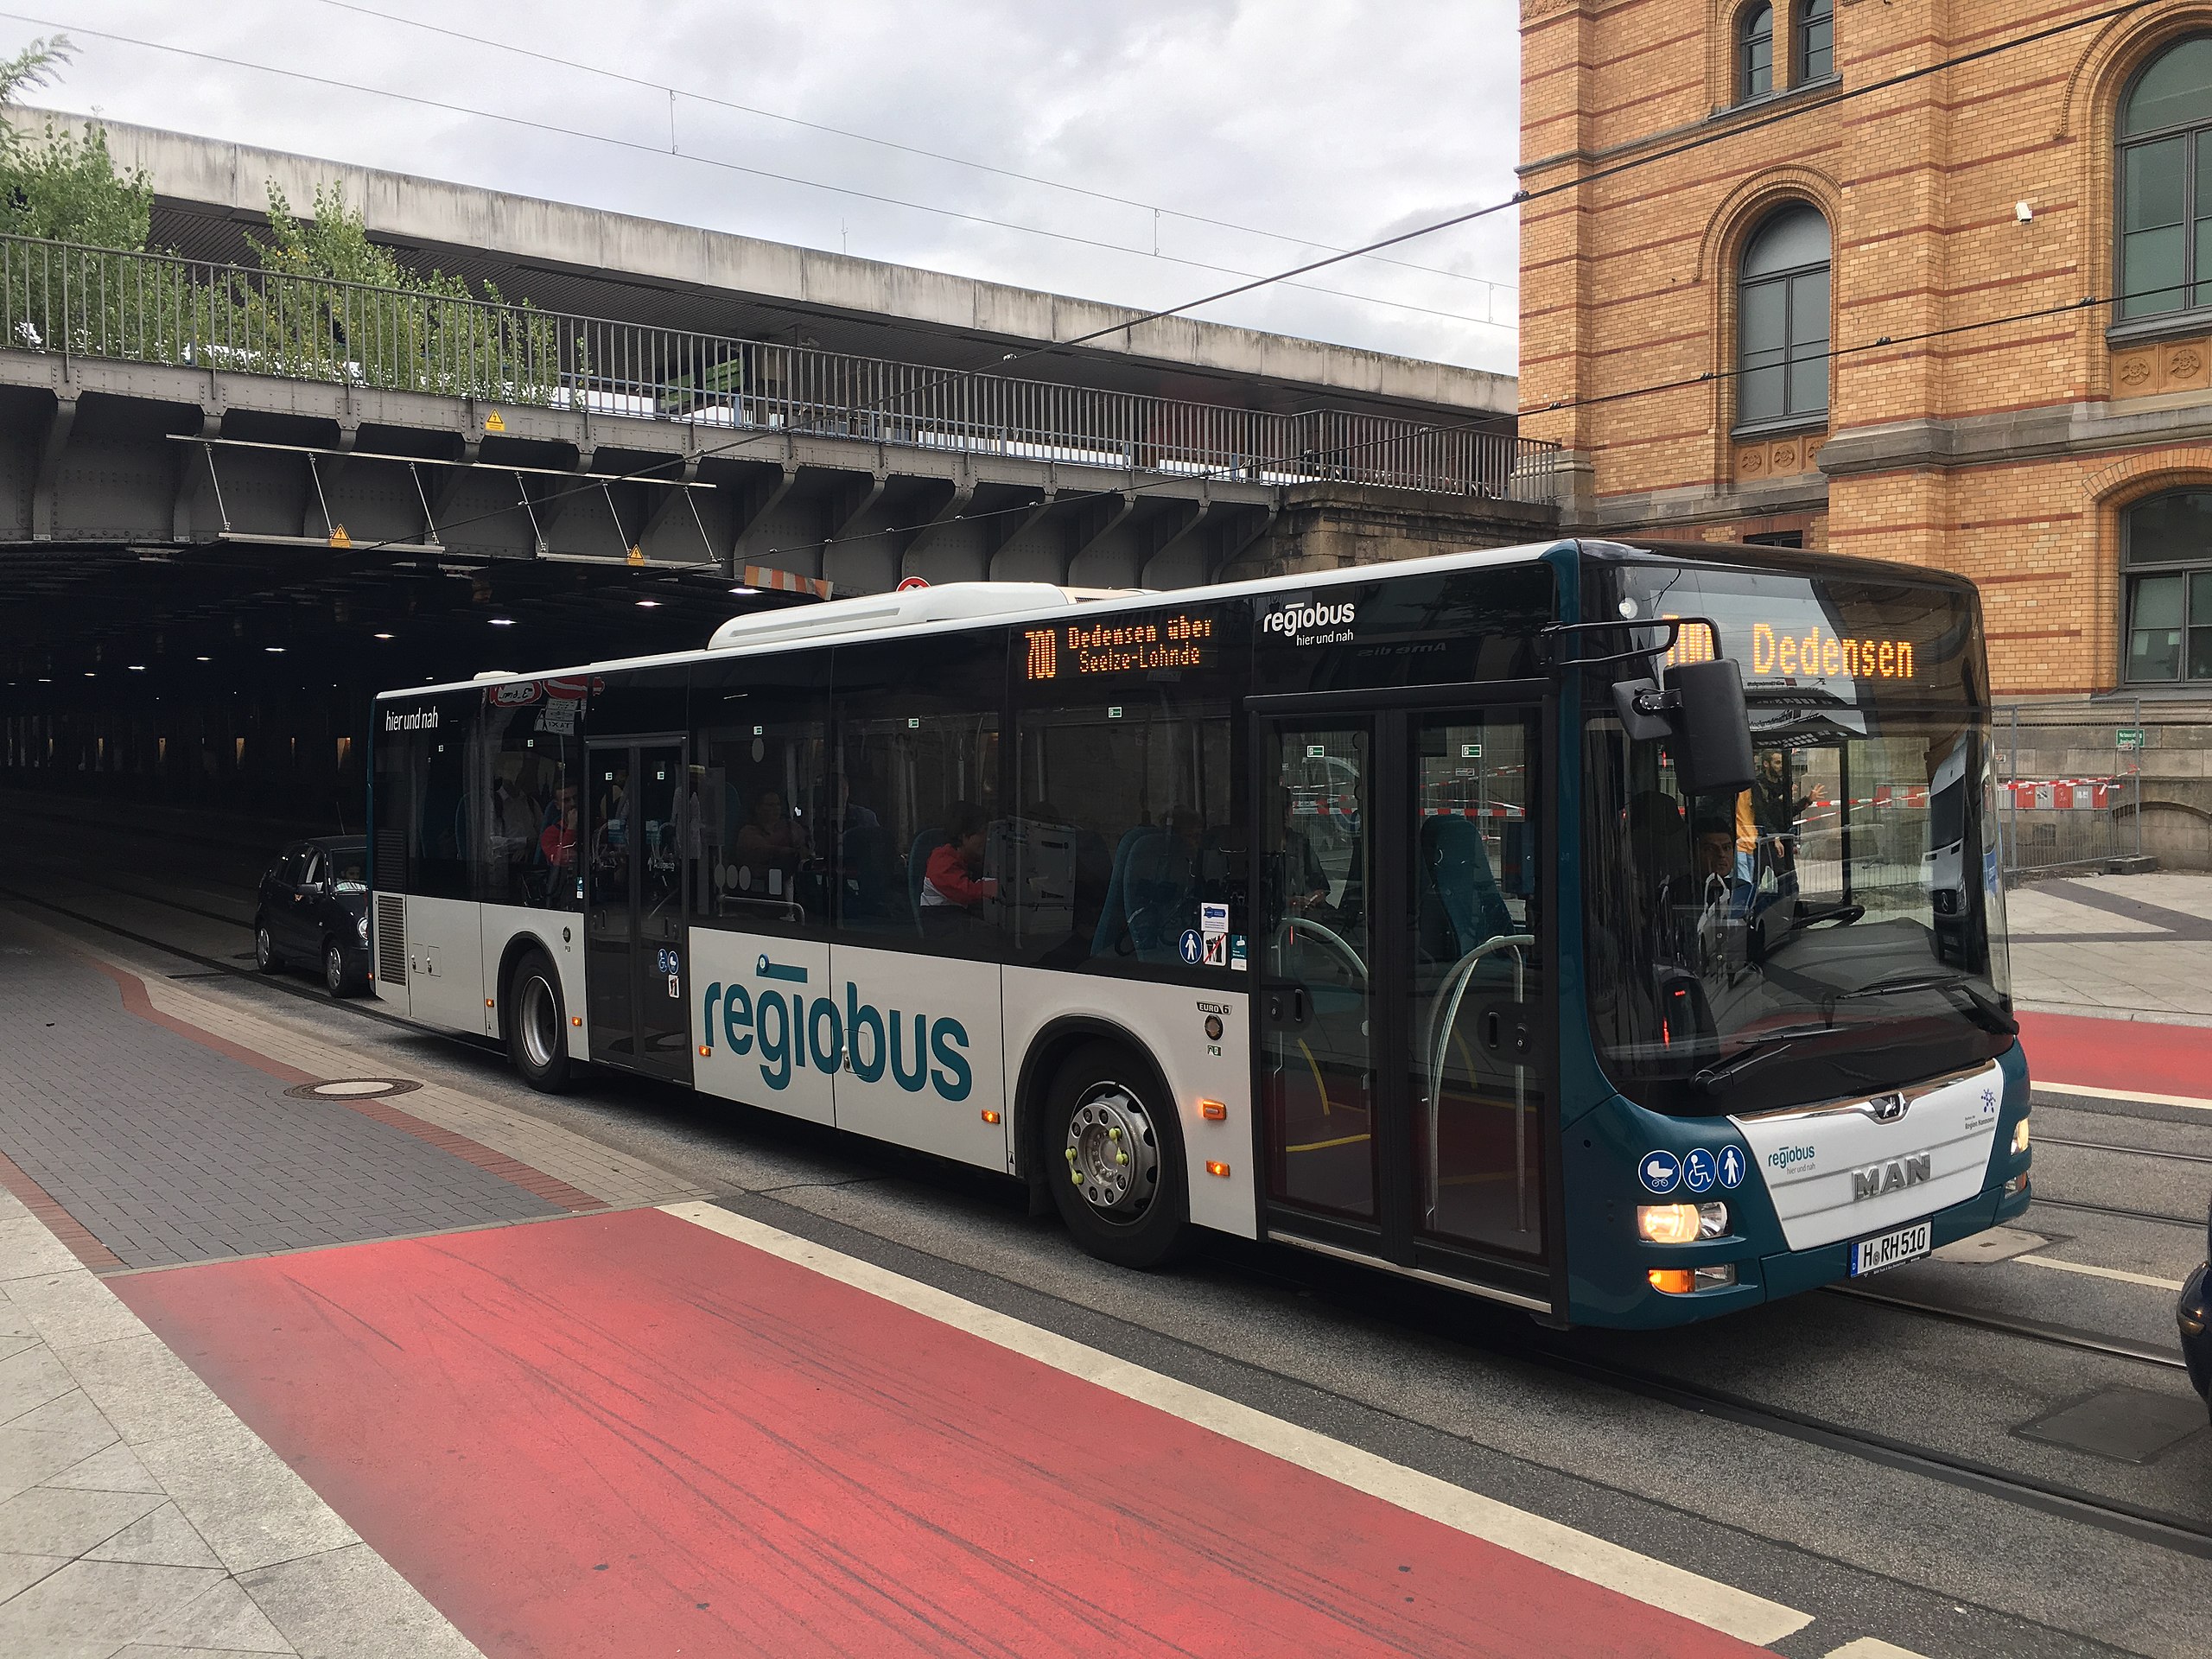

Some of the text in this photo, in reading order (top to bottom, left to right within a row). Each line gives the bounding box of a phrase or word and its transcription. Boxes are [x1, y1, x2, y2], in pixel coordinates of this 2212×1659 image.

[1068, 615, 1212, 650] Dedensen über
[1263, 601, 1355, 637] regiobus
[1296, 629, 1354, 646] hier und nah
[1752, 622, 1914, 679] Dedensen
[1024, 629, 1057, 681] 700
[1079, 641, 1201, 673] Seelze-Lohnde
[385, 705, 438, 732] hier und nah
[1198, 1003, 1230, 1014] EURO 6
[704, 962, 973, 1102] regiobus
[1768, 1146, 1815, 1169] regiobus
[1786, 1162, 1816, 1175] hier und nah
[1851, 1152, 1932, 1200] MAN
[1863, 1243, 1873, 1268] H
